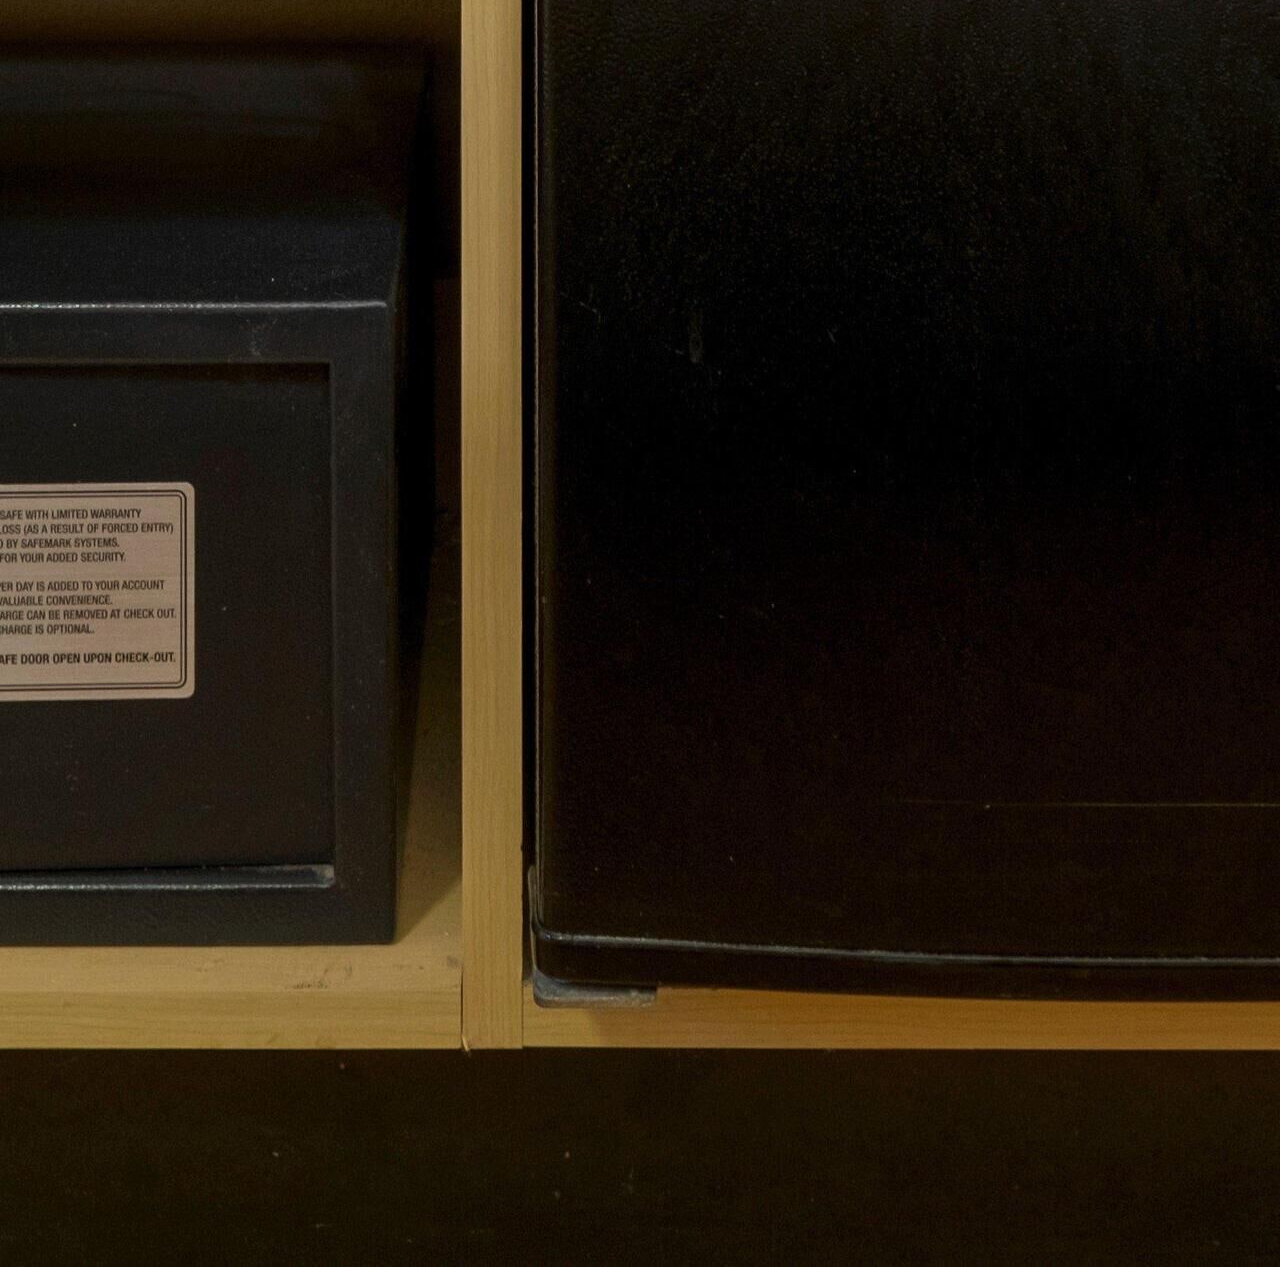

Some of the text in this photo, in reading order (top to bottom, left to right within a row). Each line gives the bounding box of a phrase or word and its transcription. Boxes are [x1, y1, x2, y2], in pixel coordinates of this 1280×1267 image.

[0, 510, 23, 520] SAFE
[26, 510, 49, 520] WITH
[51, 509, 88, 520] LIMITED
[91, 509, 141, 519] WARRANTY
[23, 524, 39, 535] (AS
[41, 524, 48, 533] A
[51, 524, 84, 533] RESULT
[87, 524, 99, 533] OF
[102, 523, 138, 533] FORCED
[141, 522, 174, 534] ENTRY)
[6, 539, 19, 549] BY
[21, 538, 72, 548] SAFEMARK
[74, 537, 120, 548] SYSTEMS.
[0, 554, 17, 564] FOR
[20, 553, 44, 563] YOUR
[46, 553, 78, 563] ADDED
[15, 581, 34, 592] DAY
[36, 581, 46, 591] IS
[47, 581, 79, 591] ADDED
[81, 581, 93, 591] TO
[95, 580, 119, 591] YOUR
[121, 580, 165, 590] ACCOUNT
[46, 595, 113, 606] CONVENIENCE.
[26, 610, 46, 621] CAN
[48, 610, 61, 620] BE
[63, 610, 108, 620] REMOVED
[110, 609, 121, 619] AT
[123, 609, 155, 619] CHECK
[157, 608, 177, 619] OUT.
[35, 625, 44, 634] IS
[46, 624, 95, 634] OPTIONAL.
[20, 653, 50, 665] DOOR
[53, 653, 80, 664] OPEN
[83, 653, 112, 664] UPON
[115, 651, 176, 663] CHECK-OUT.
